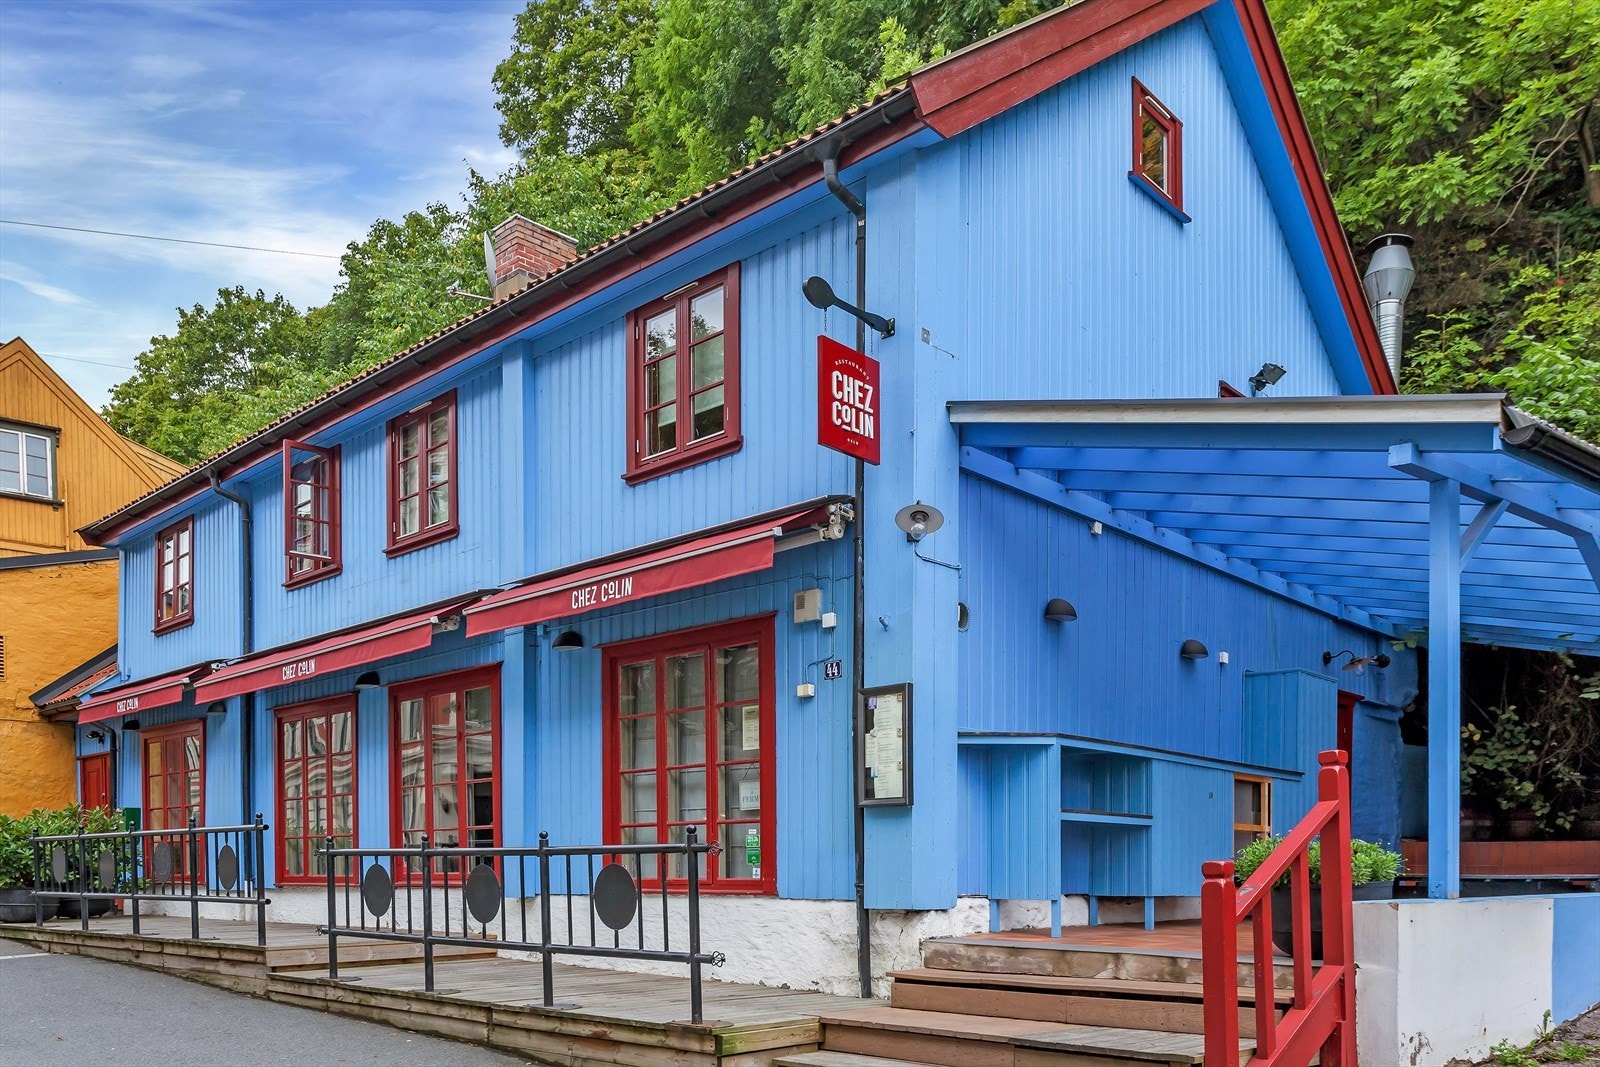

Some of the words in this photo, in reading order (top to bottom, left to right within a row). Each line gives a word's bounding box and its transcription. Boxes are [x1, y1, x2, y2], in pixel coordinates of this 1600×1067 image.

[834, 359, 870, 380] RESTAURANT
[832, 370, 874, 414] CHEZ
[832, 401, 874, 440] COLIN
[571, 585, 597, 609] CHEZ
[601, 576, 633, 602] COLIN
[282, 663, 297, 681] CHEZ
[297, 658, 316, 677] COLIN
[826, 662, 838, 677] 44
[116, 700, 126, 713] CHEZ
[742, 795, 759, 803] FERM
